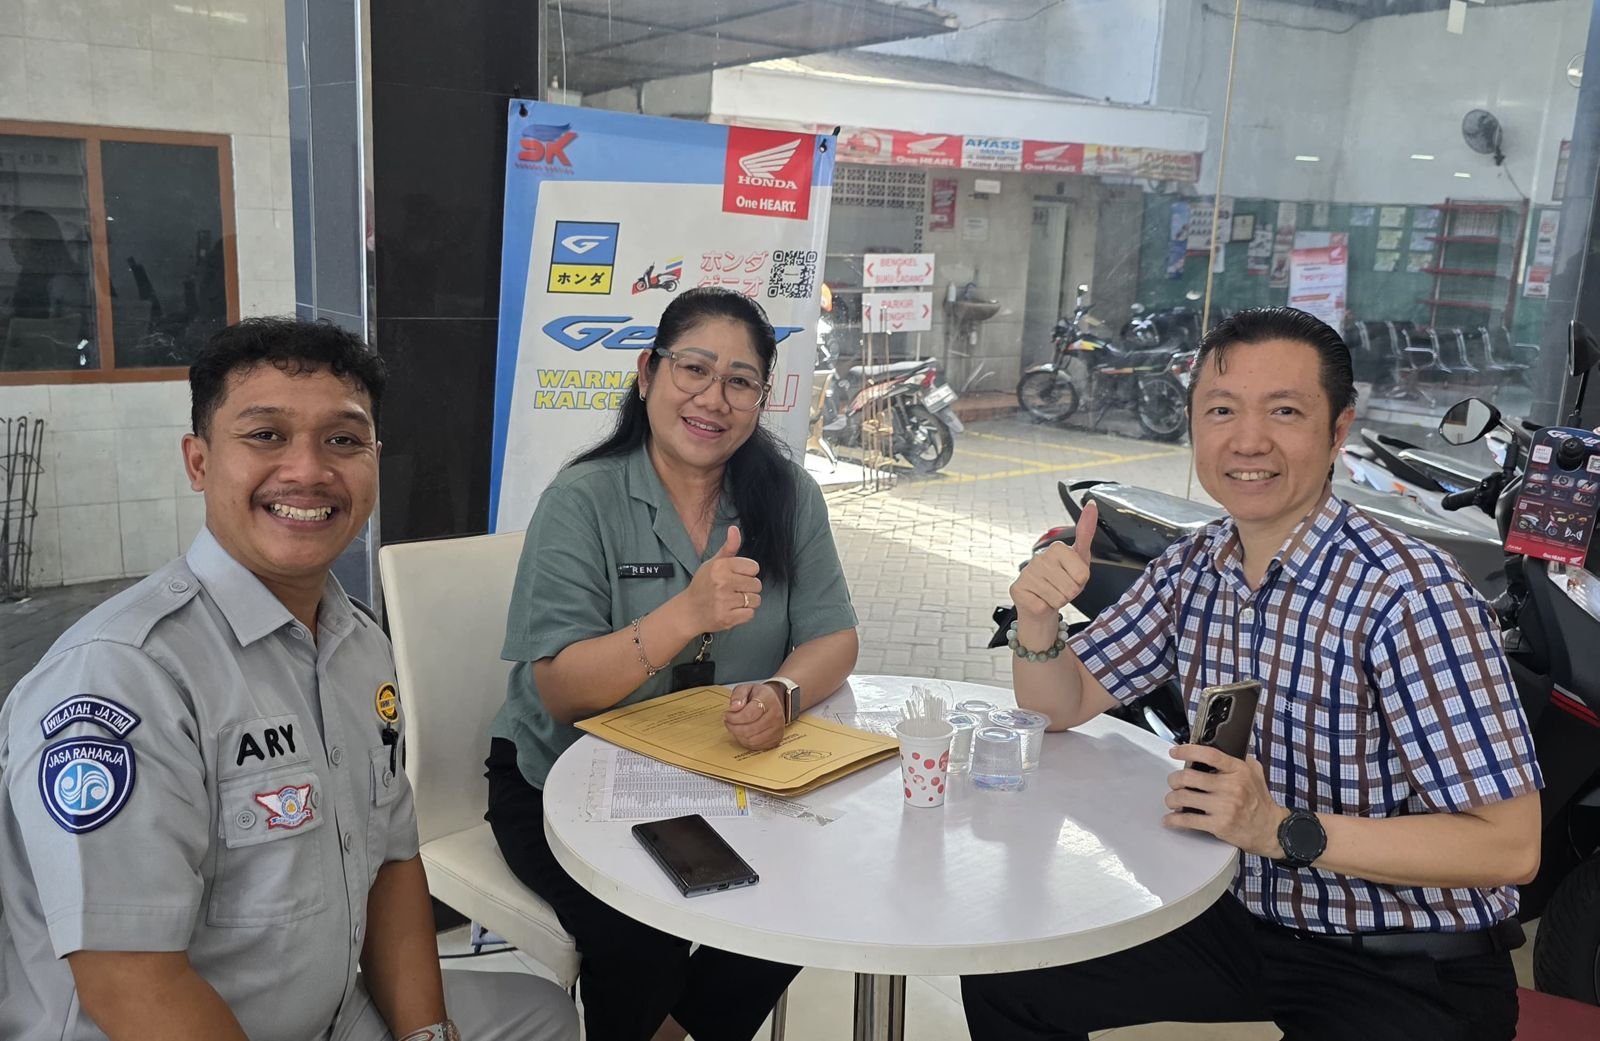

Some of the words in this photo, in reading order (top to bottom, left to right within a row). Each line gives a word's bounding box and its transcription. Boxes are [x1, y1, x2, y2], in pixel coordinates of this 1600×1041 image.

[965, 139, 1020, 150] AHASS
[737, 175, 798, 190] HONDA
[735, 195, 758, 209] One
[759, 197, 797, 213] HEART.
[701, 250, 769, 273] ホンダ
[557, 271, 606, 287] ホンダ
[534, 391, 625, 411] KALCE
[47, 703, 91, 729] WILAYAH
[95, 706, 128, 729] JATIM
[236, 723, 297, 766] ARY
[48, 750, 72, 768] JASA
[73, 747, 124, 766] RAHARJA
